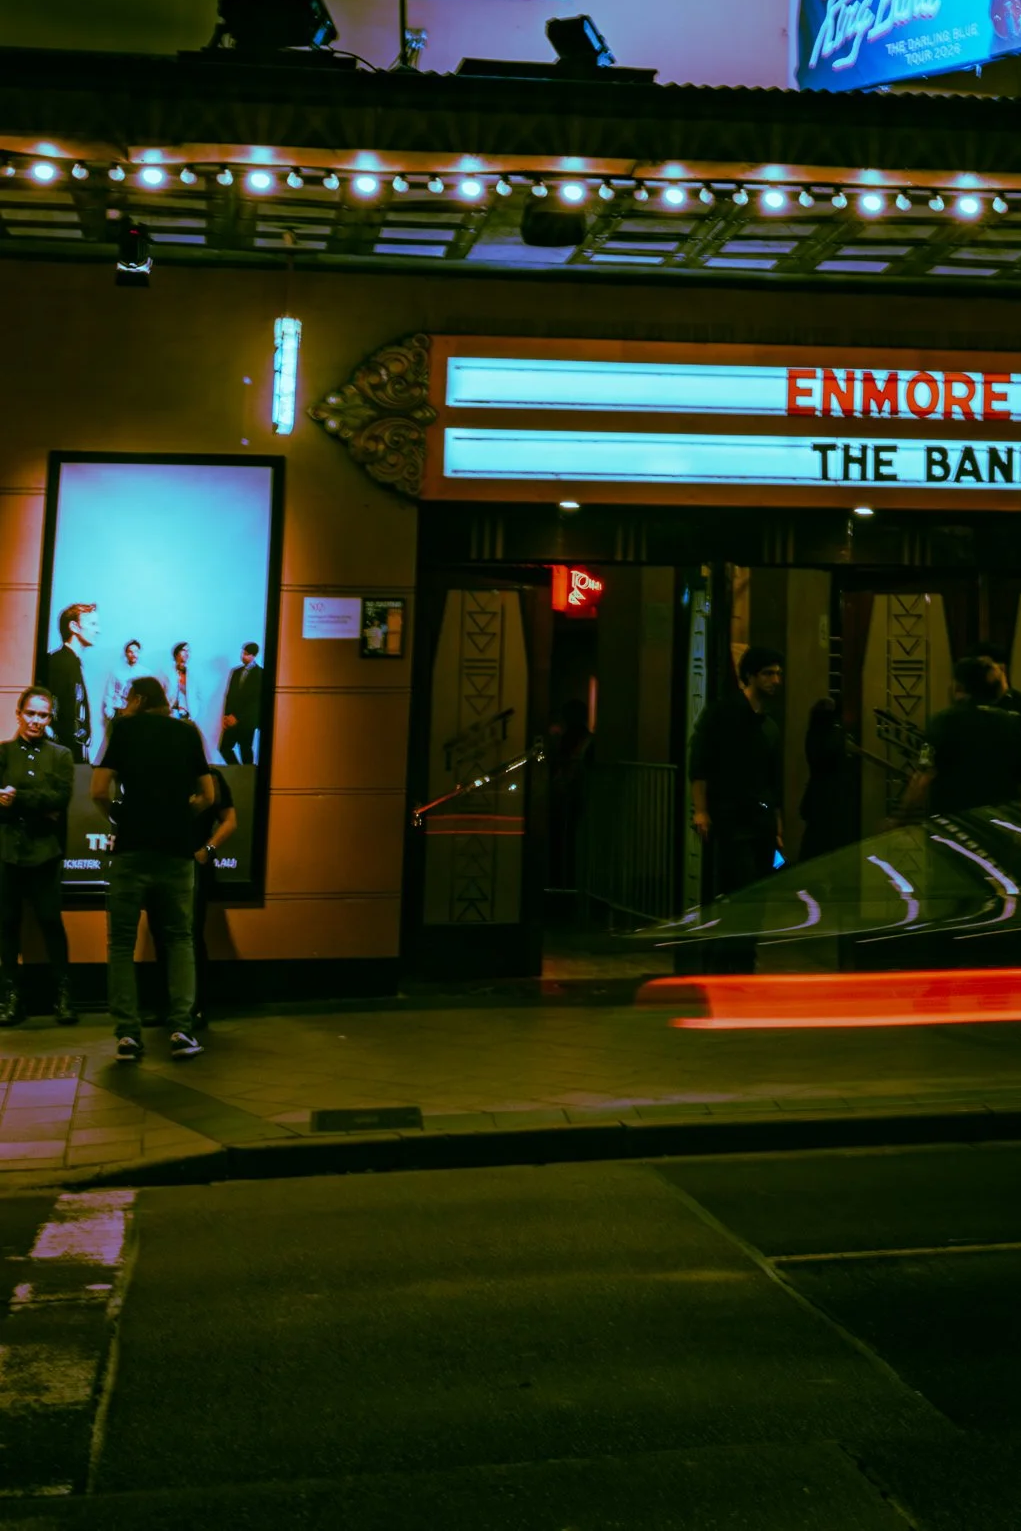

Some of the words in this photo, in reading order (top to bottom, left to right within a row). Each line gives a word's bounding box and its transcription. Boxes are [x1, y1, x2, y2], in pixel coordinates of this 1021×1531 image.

[885, 40, 907, 56] THE
[905, 50, 933, 66] TOUR
[786, 367, 1012, 421] ENMORE
[811, 443, 898, 481] THE
[86, 833, 117, 852] TH
